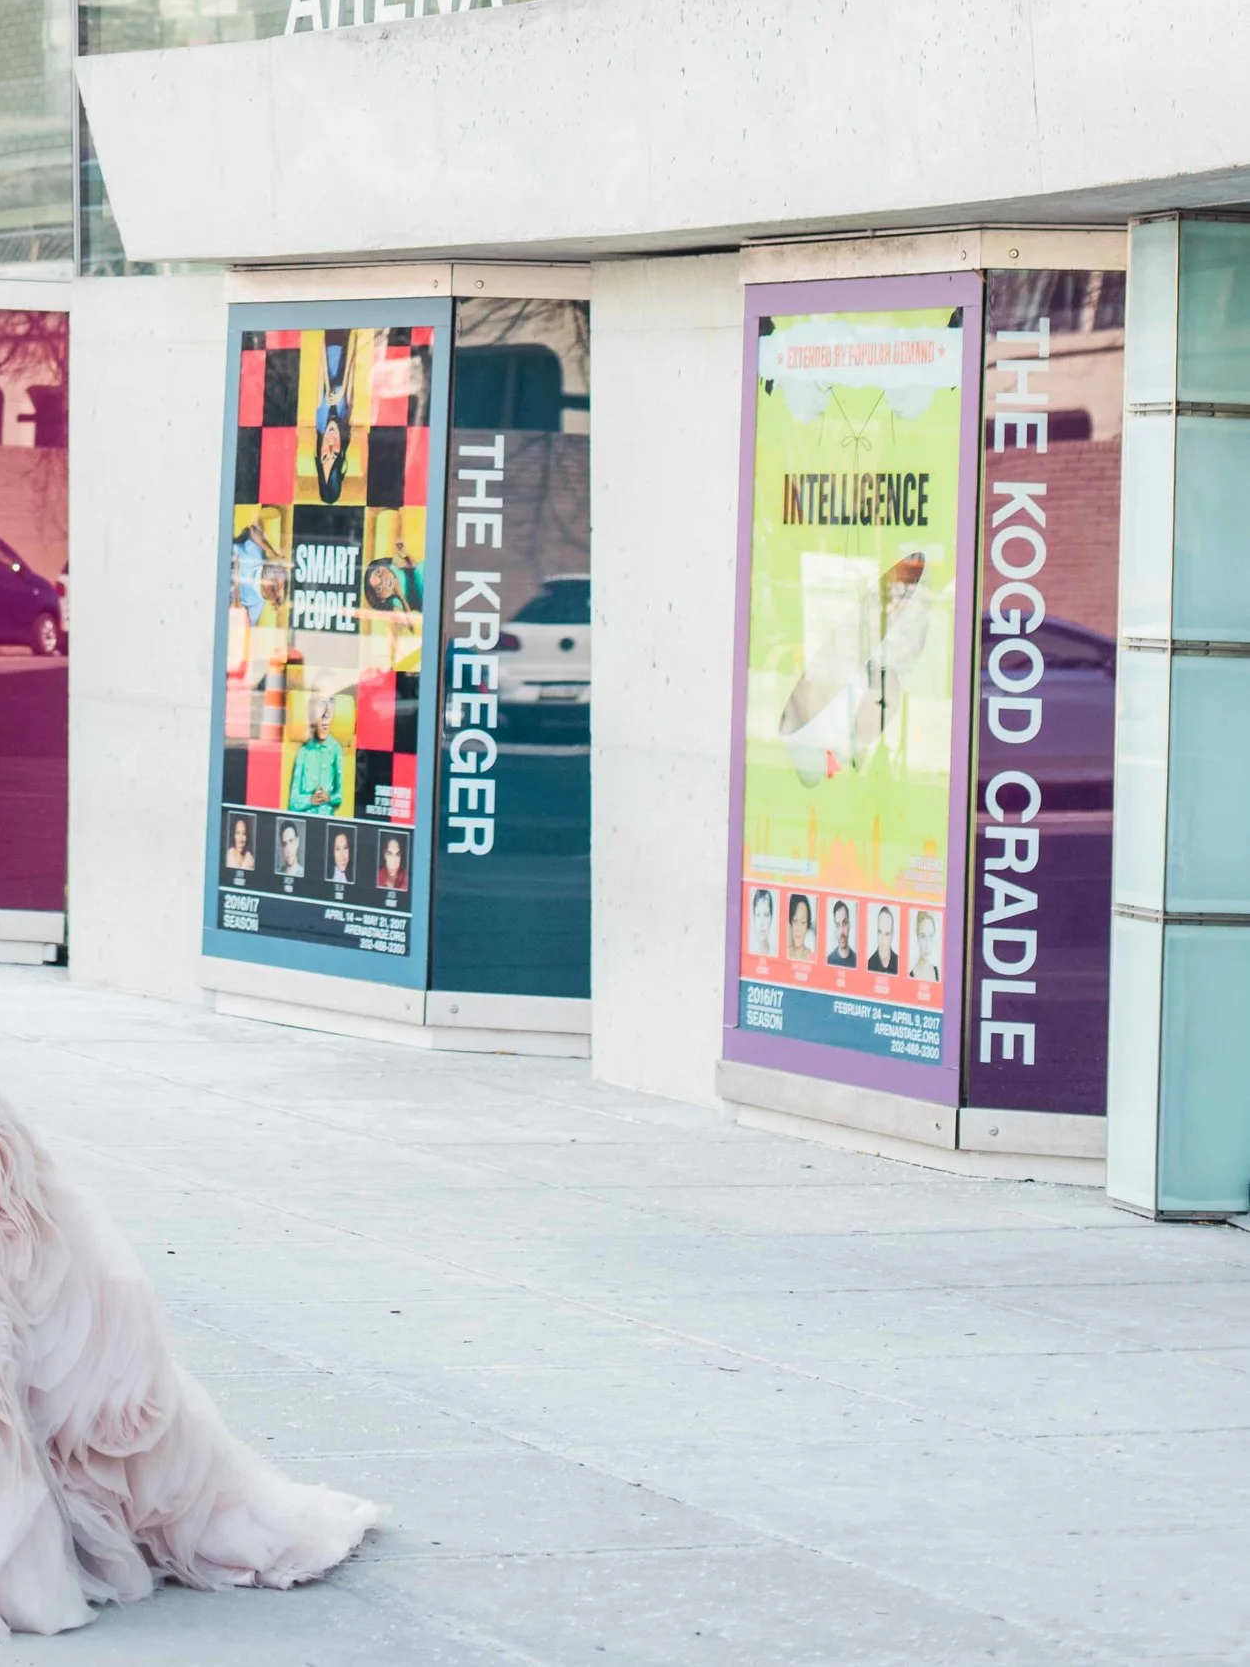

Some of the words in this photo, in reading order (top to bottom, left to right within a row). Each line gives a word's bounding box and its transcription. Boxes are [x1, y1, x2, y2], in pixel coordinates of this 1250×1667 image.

[787, 345, 832, 370] EXTENDED
[833, 344, 847, 368] BY
[848, 342, 891, 367] POPULAR
[893, 341, 935, 365] DEMAND
[994, 317, 1050, 453] THE
[456, 434, 505, 549] THE
[783, 472, 930, 527] INTELLIGENCE
[294, 543, 360, 585] SMART
[292, 589, 357, 632] PEOPLE
[987, 481, 1048, 745] KOGOD
[447, 570, 502, 856] KREEGER
[223, 893, 260, 911] 2016/17
[223, 914, 259, 932] SEASON
[979, 770, 1042, 1066] CRADLE
[747, 986, 784, 1008] 2016/17
[833, 1001, 872, 1019] FEBRUARY
[871, 1006, 882, 1021] 24
[891, 1011, 914, 1027] APRIL
[923, 1016, 941, 1031] 2017
[746, 1009, 783, 1031] SEASON
[873, 1022, 941, 1045] ARENASTAGE.ORG
